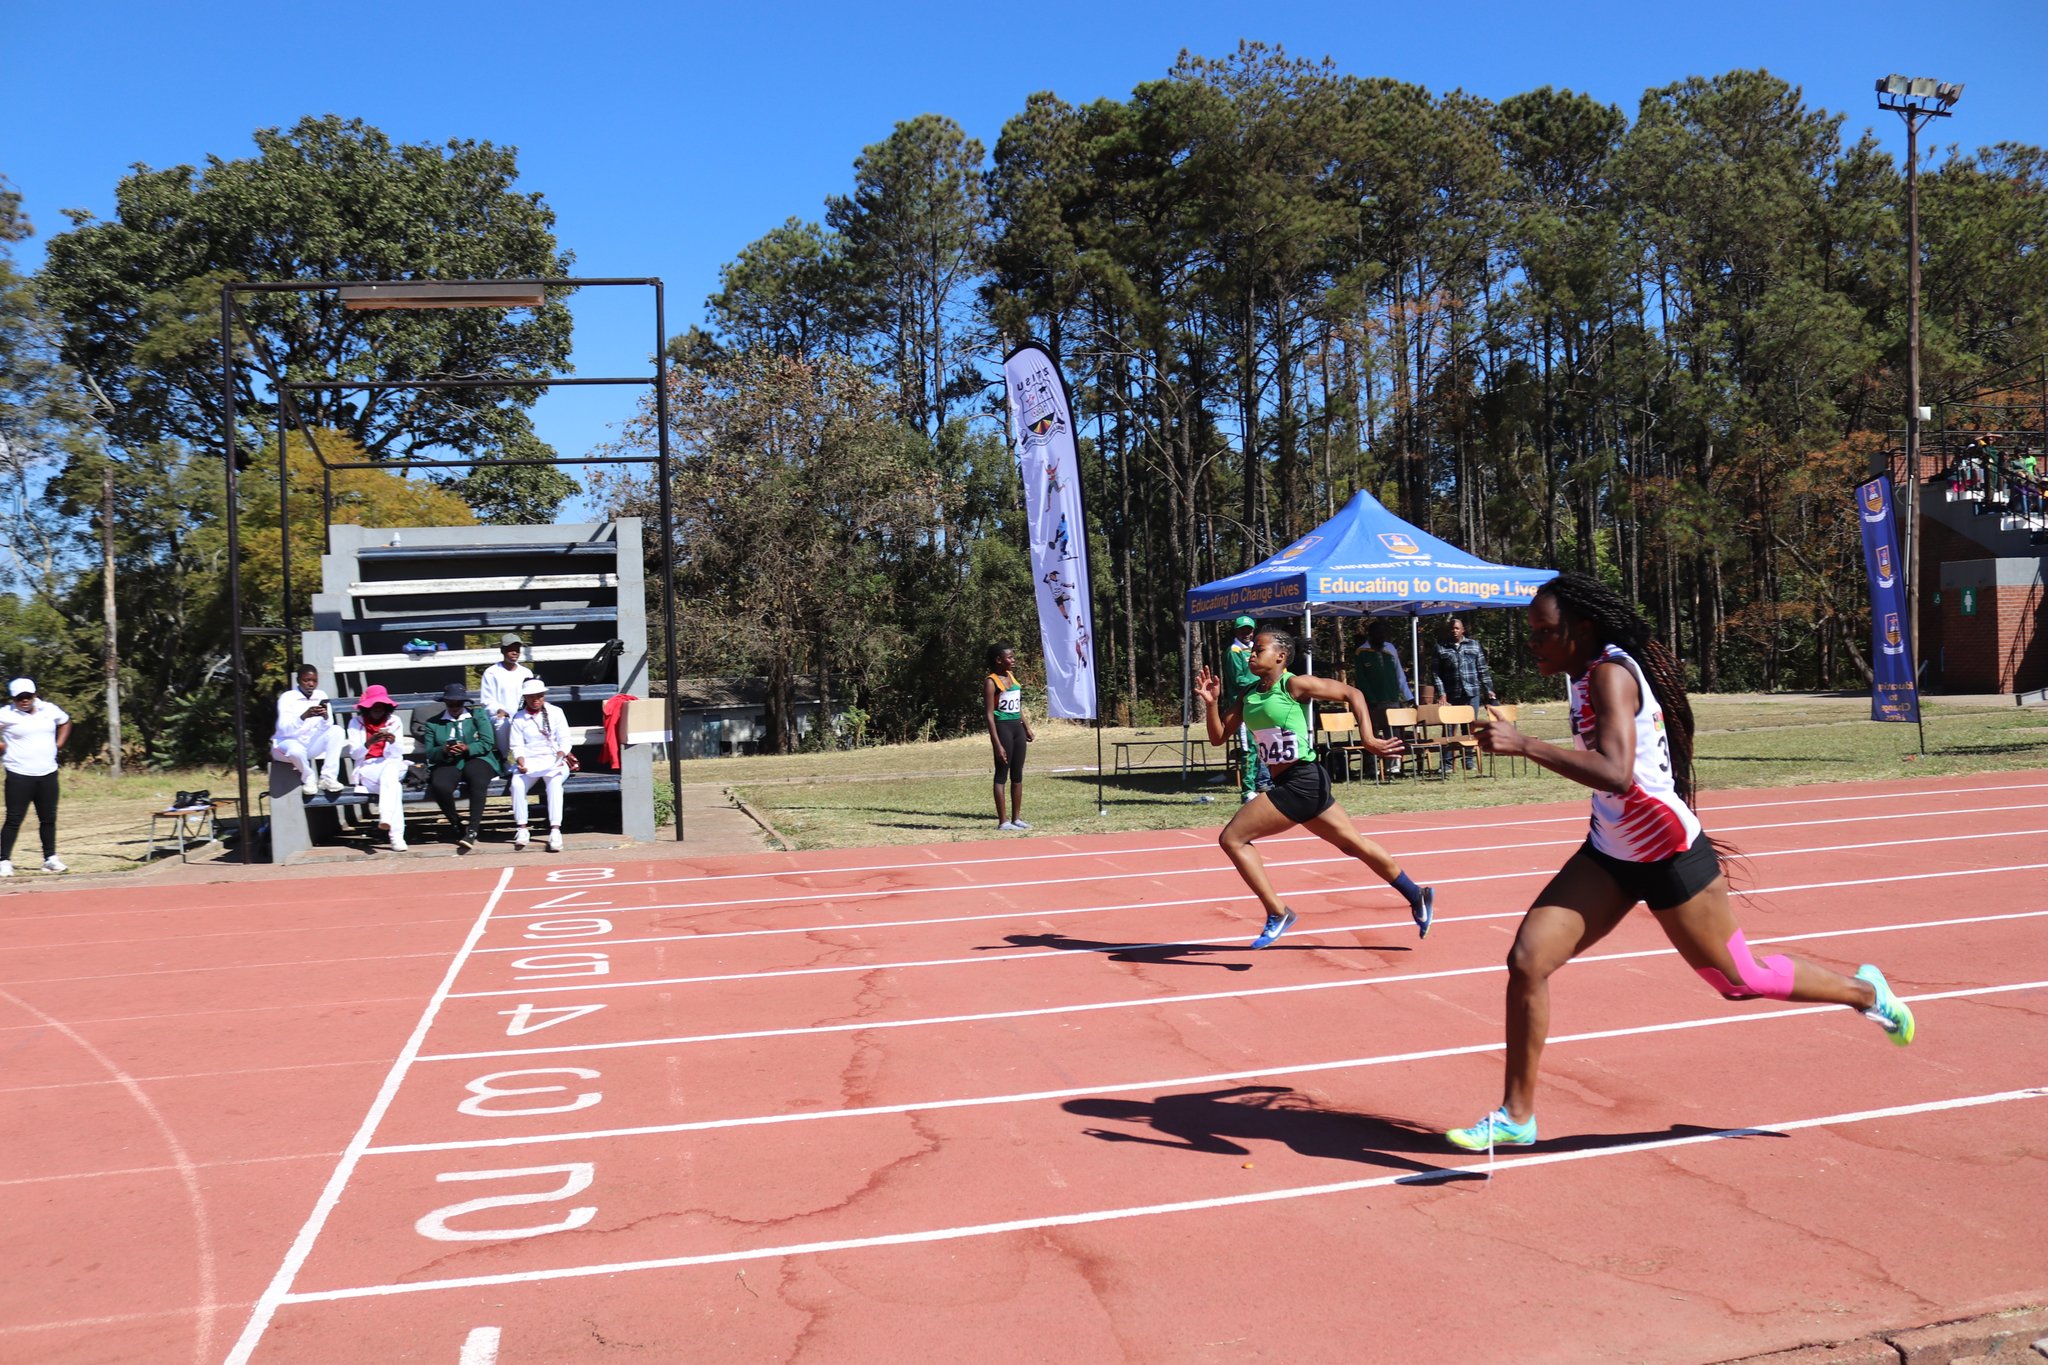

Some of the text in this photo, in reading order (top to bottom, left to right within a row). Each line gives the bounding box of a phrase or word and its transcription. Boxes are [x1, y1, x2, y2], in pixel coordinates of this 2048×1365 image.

[1191, 594, 1229, 614] Educating
[1231, 591, 1239, 604] to
[1241, 586, 1273, 603] Change
[1275, 582, 1300, 597] Lives
[1319, 577, 1538, 598] Educating to Change Live
[999, 698, 1020, 711] 203
[545, 867, 615, 882] 8
[529, 891, 613, 909] 7
[511, 952, 610, 980] 5
[497, 1003, 607, 1036] 4
[457, 1067, 603, 1117] 3
[415, 1162, 598, 1242] 2
